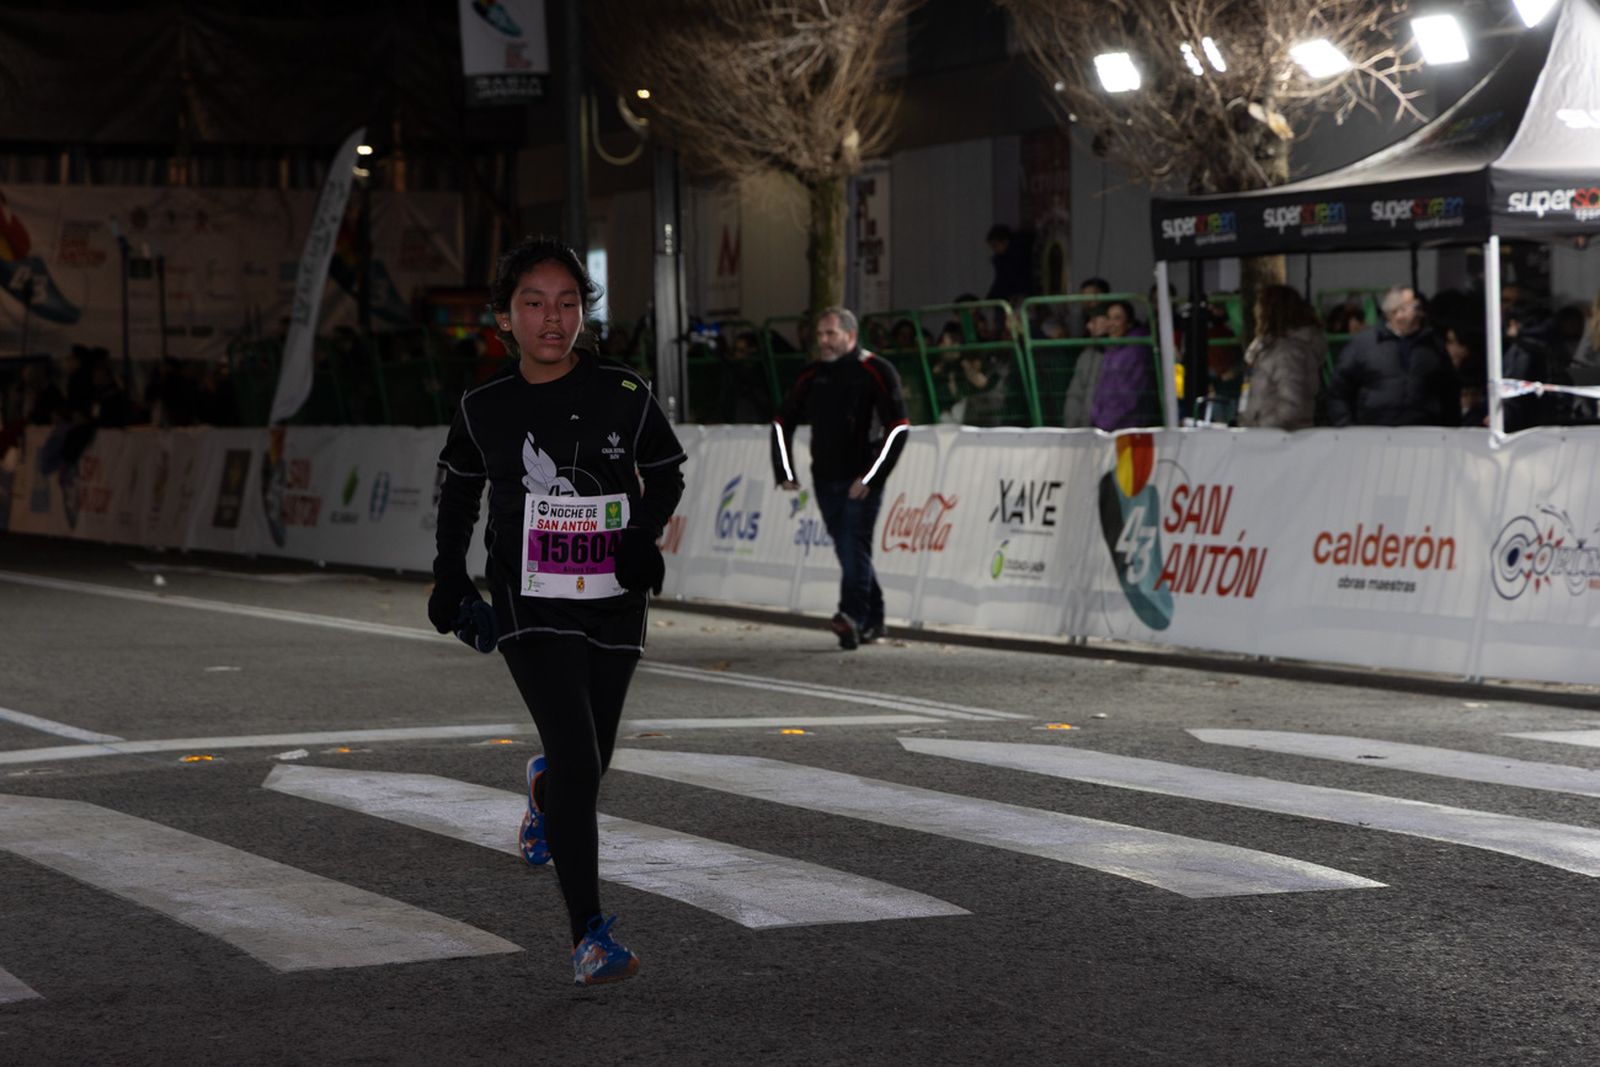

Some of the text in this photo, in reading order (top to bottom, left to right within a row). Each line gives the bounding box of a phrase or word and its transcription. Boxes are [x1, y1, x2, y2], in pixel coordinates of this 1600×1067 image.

[537, 519, 559, 530] SAN
[560, 516, 598, 531] ANTÓN
[550, 507, 597, 518] NOCHE DE
[989, 479, 1063, 526] XAVE
[1164, 483, 1233, 535] SAN
[1115, 506, 1157, 585] 43
[1153, 529, 1268, 598] ANTÓN
[1313, 523, 1457, 570] calderón
[1337, 575, 1417, 593] obras maestras
